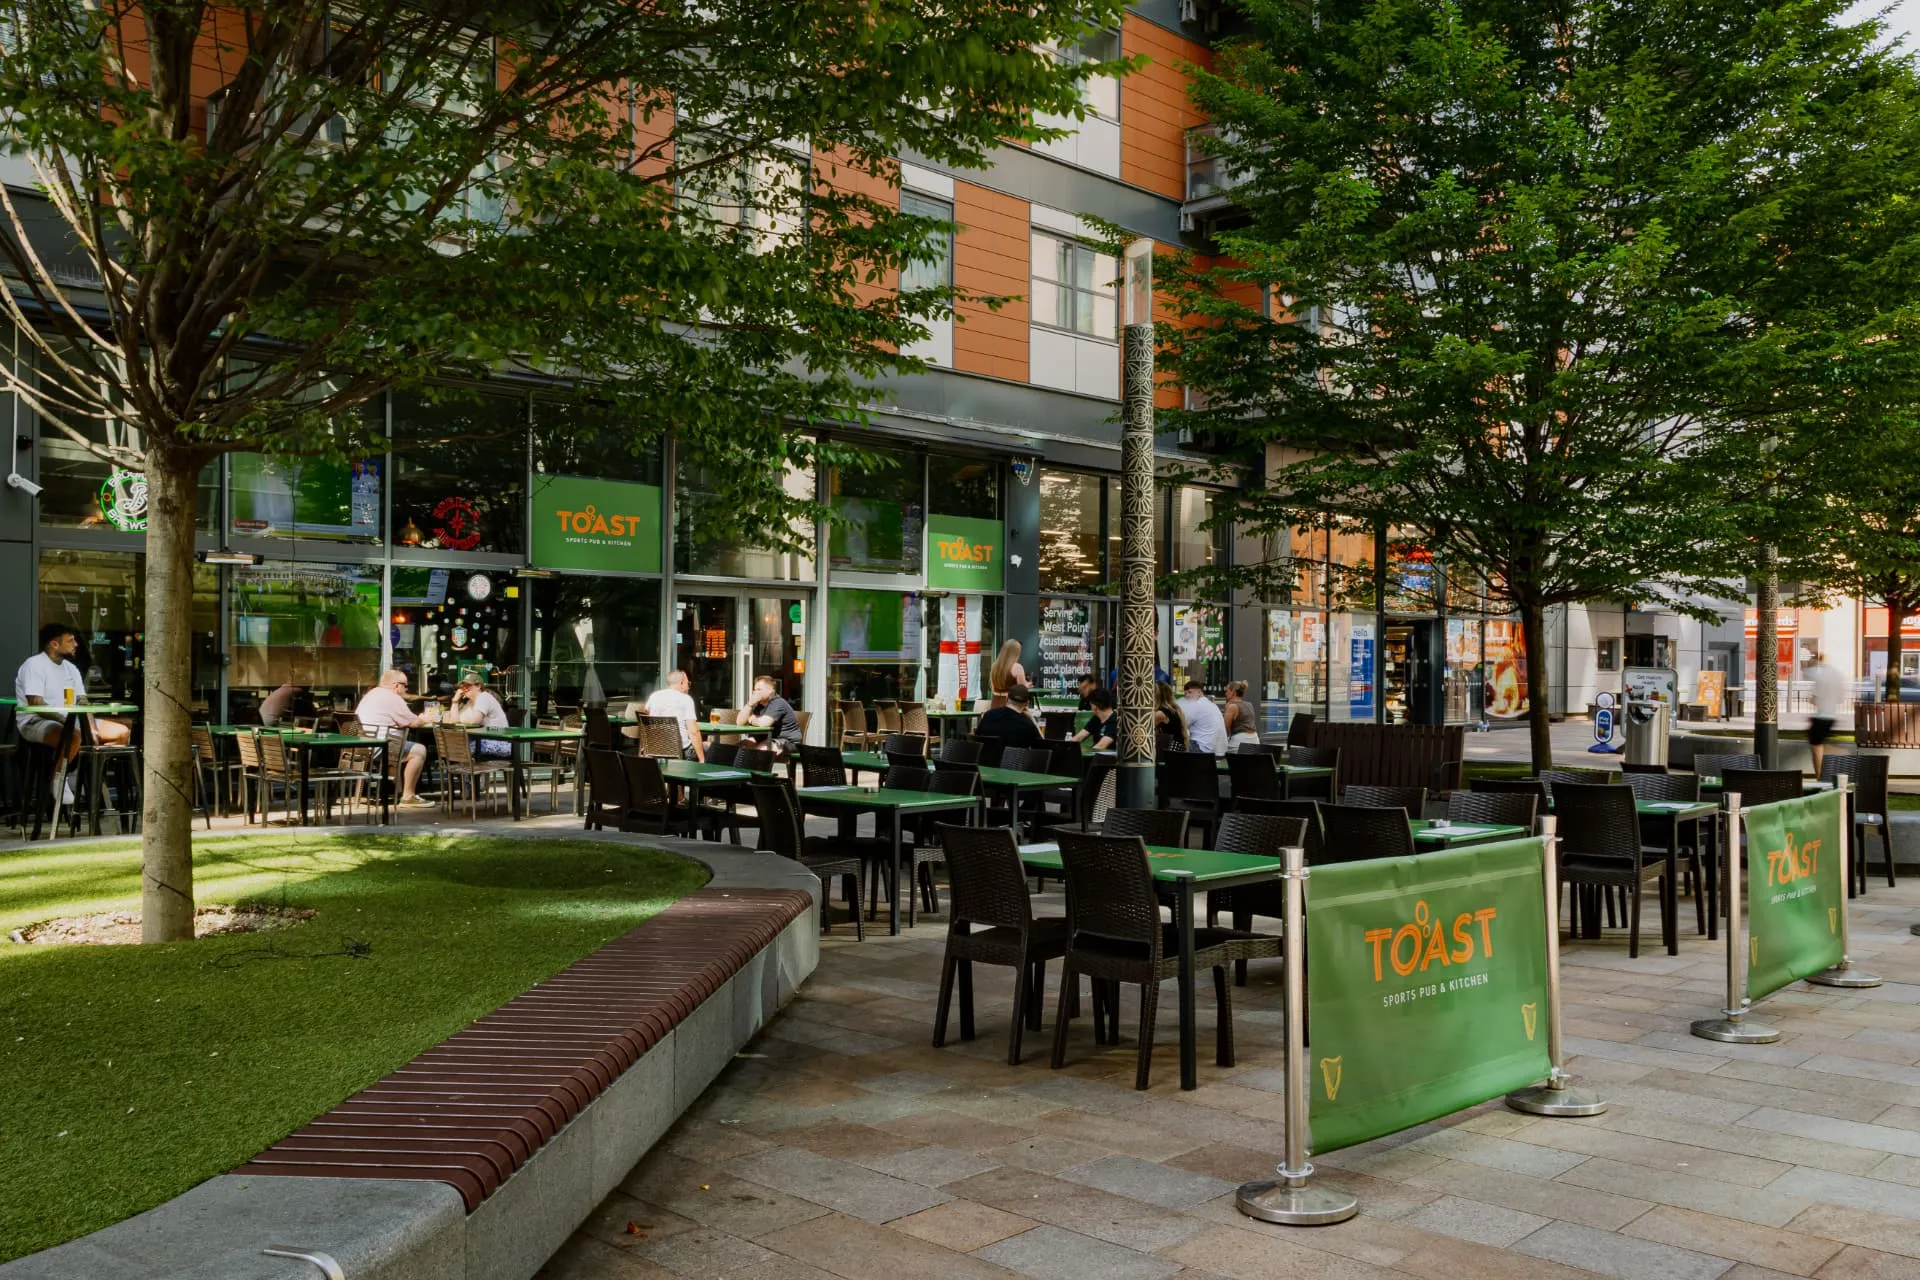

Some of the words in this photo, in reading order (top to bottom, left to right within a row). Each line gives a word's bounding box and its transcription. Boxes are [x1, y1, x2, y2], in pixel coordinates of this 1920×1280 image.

[107, 509, 148, 530] BREWE
[556, 509, 641, 537] TOAST
[937, 540, 993, 563] TOAST
[1043, 607, 1074, 621] Serving
[1043, 621, 1065, 633] West
[1067, 622, 1089, 633] Point
[959, 663, 968, 689] HOME
[1043, 663, 1059, 674] and
[1767, 838, 1822, 888] TOAST
[1364, 906, 1497, 982] TOAST
[1383, 989, 1417, 1008] SPORTS
[1419, 984, 1437, 999] PUB
[1440, 982, 1446, 993] &
[1449, 973, 1489, 991] KITCHEN
